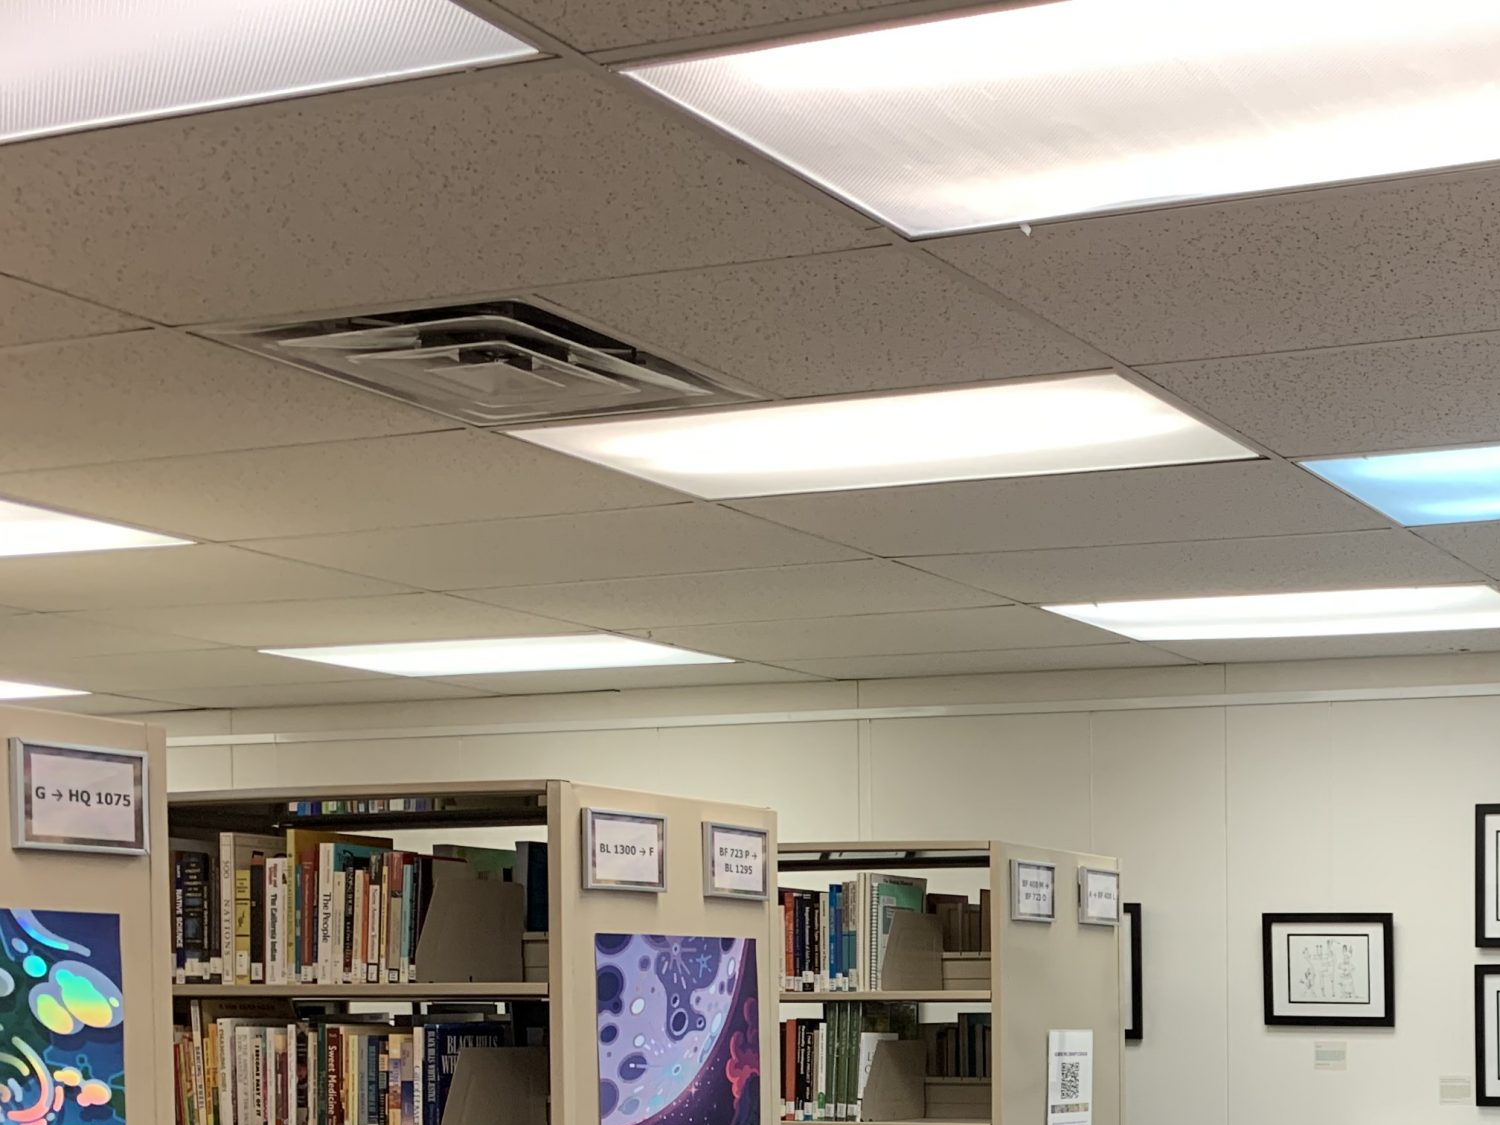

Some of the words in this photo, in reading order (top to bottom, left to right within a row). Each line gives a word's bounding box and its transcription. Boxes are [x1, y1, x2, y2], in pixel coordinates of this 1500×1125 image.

[35, 786, 46, 799] G
[69, 789, 91, 806] HQ
[96, 792, 131, 807] 1075
[600, 843, 611, 854] BL
[615, 844, 636, 855] 1300
[649, 847, 654, 856] F
[719, 847, 728, 857] BF
[730, 848, 743, 858] 723
[725, 863, 733, 873] BL
[736, 864, 752, 874] 1295
[175, 889, 183, 914] NATIVE
[322, 892, 331, 911] The
[176, 917, 184, 948] SCIENCE
[223, 900, 231, 956] NATIONS
[270, 908, 278, 939] California
[321, 912, 331, 943] People
[270, 940, 278, 962] Indian
[328, 1045, 337, 1072] Sweet
[328, 1074, 337, 1115] Medicine
